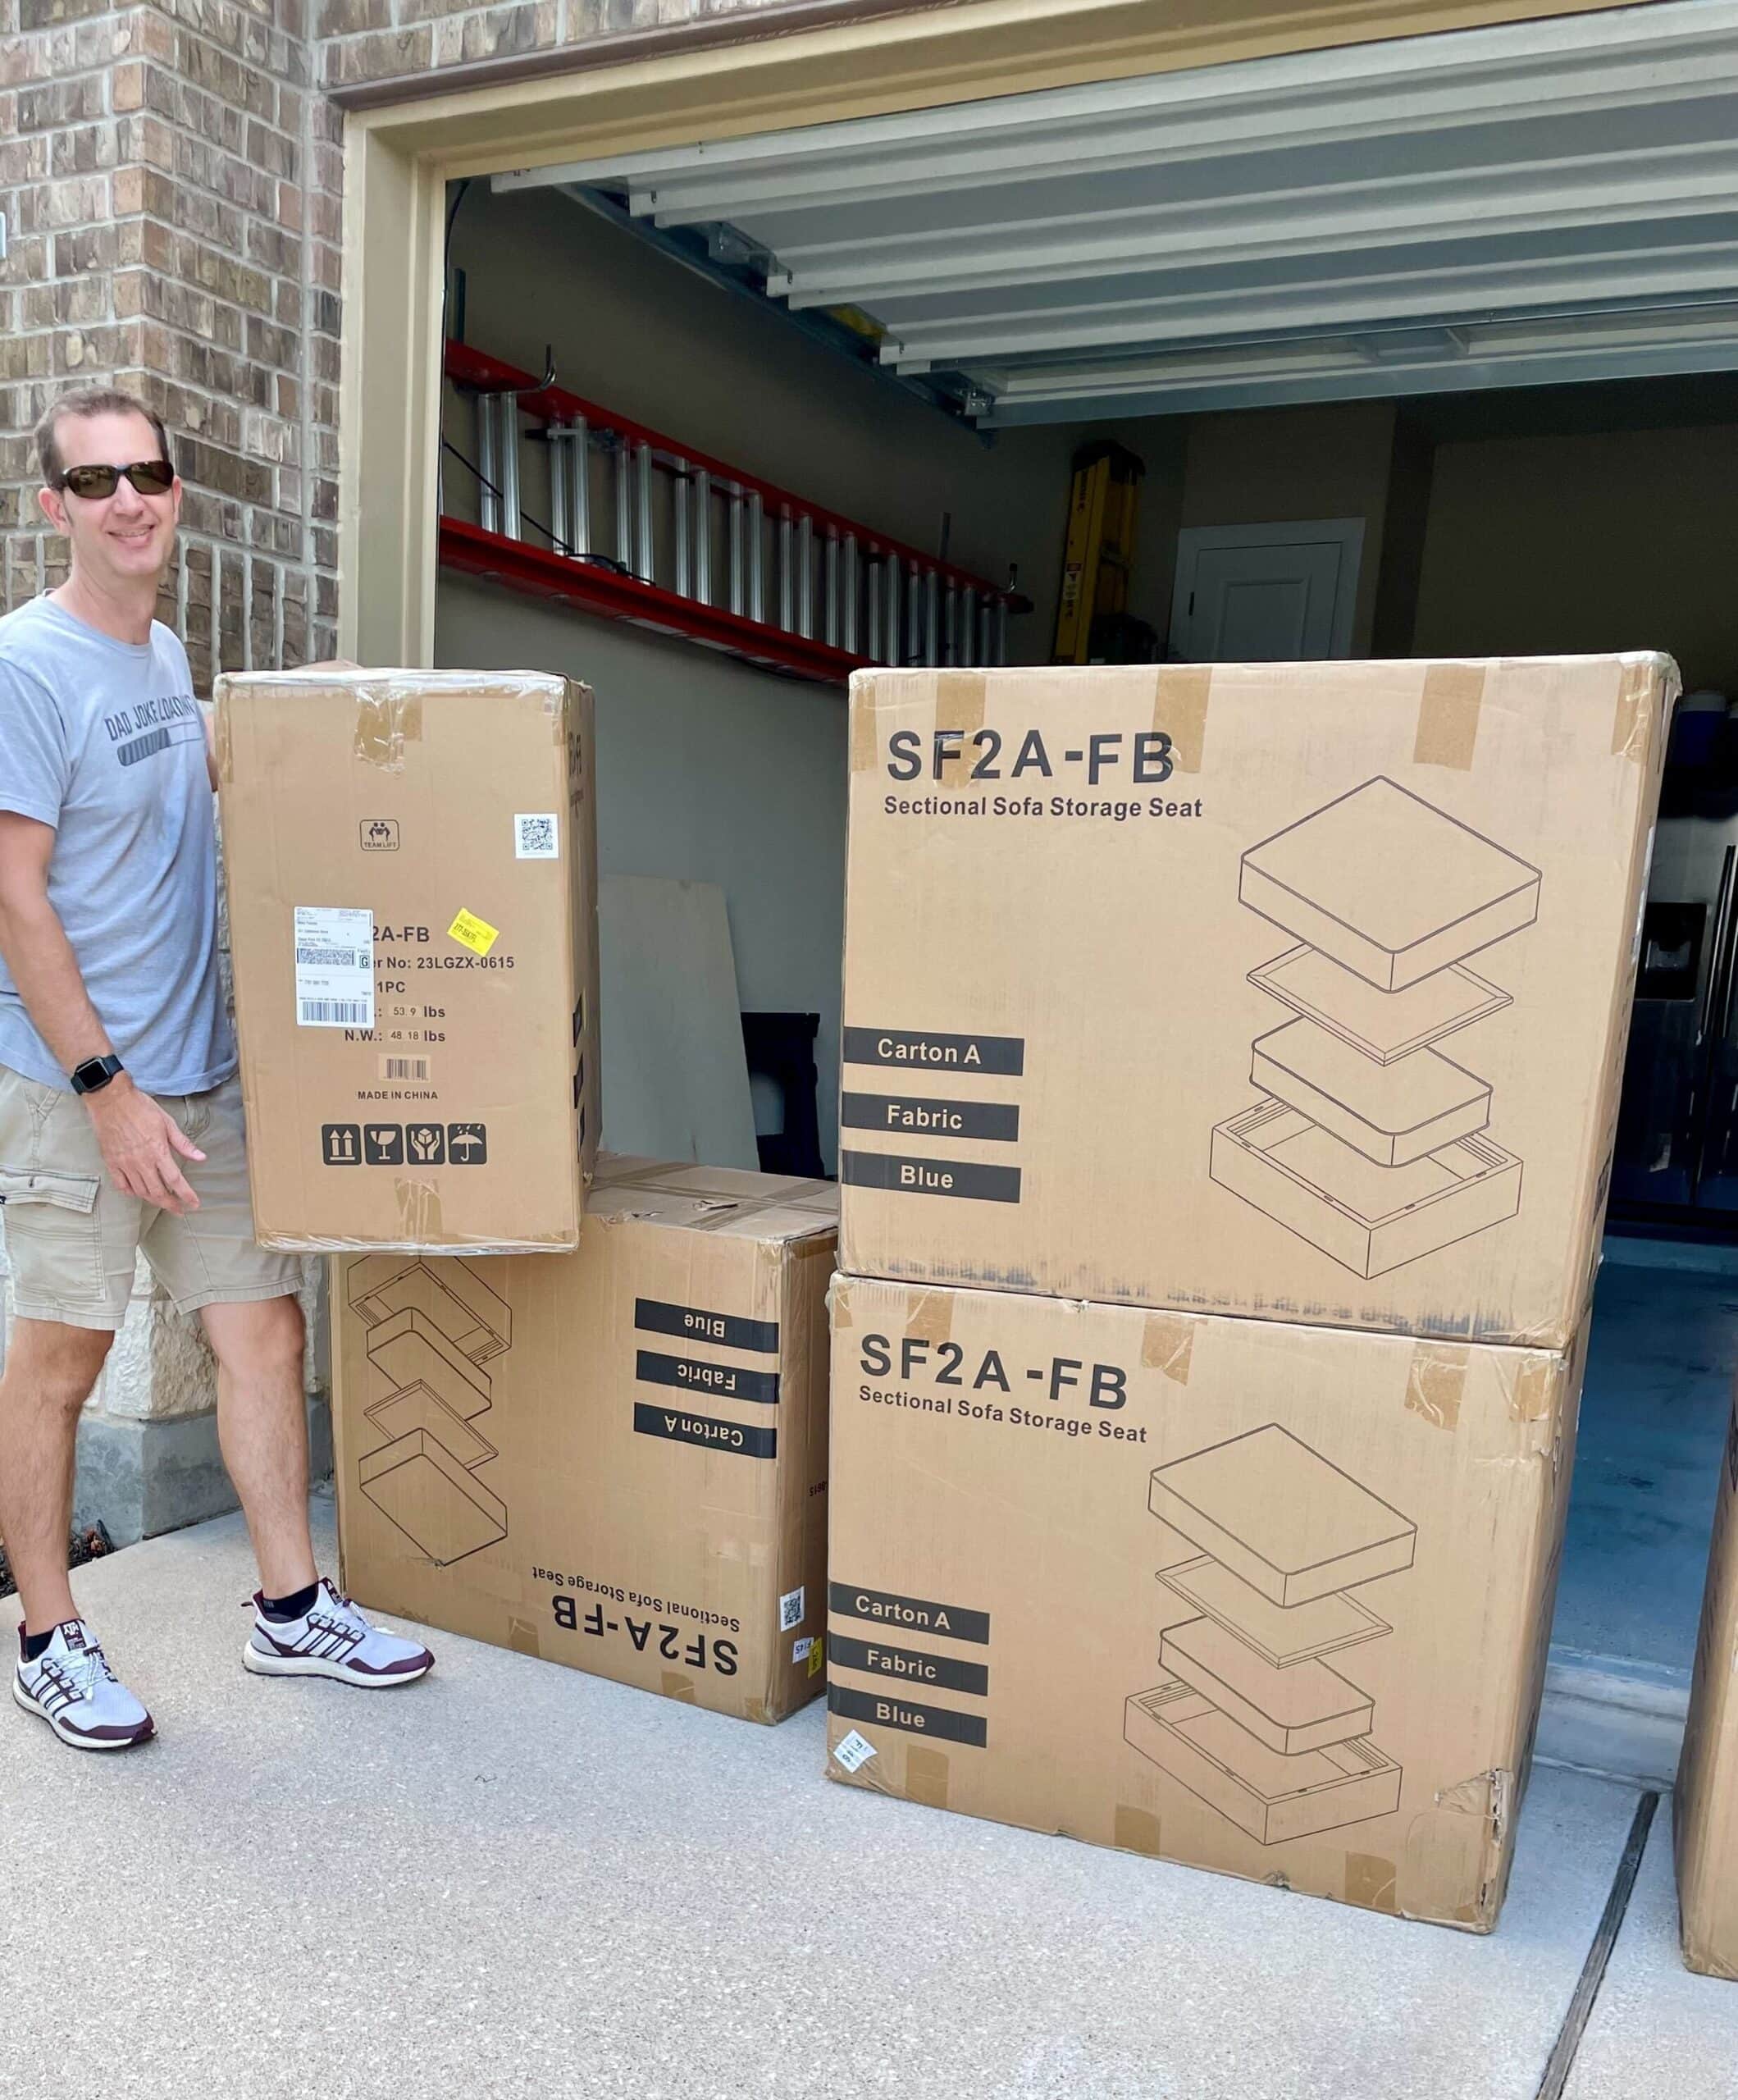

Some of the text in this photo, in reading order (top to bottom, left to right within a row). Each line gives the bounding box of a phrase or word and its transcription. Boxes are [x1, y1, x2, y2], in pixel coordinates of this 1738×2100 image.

[104, 710, 133, 741] DAD
[133, 701, 159, 729] JOKE
[887, 729, 1175, 785] SF2A-FB
[883, 796, 1203, 821] Sectional Sofa Storage Seat
[374, 926, 431, 943] 2A-FB
[386, 956, 411, 969] No:
[417, 956, 515, 969] 23LGZX-0615
[423, 1006, 446, 1018] lbs
[424, 1029, 446, 1042] lbs
[877, 1038, 982, 1065] Carton A
[358, 1091, 439, 1100] MADE IN CHINA
[887, 1104, 963, 1130] Fabric
[901, 1164, 954, 1189] Blue
[684, 1314, 726, 1338] Blue
[677, 1364, 736, 1390] Fabric
[860, 1334, 1128, 1410] SF2A-FB
[859, 1386, 1147, 1443] Sectional Sofa Storage Seat
[664, 1416, 743, 1446] Carton A
[532, 1567, 741, 1632] Sectional Sofa Storage Seat
[855, 1596, 951, 1629] Carton A
[552, 1595, 738, 1676] SF2A-FB
[868, 1650, 937, 1678] Fabric
[877, 1703, 926, 1728] Blue
